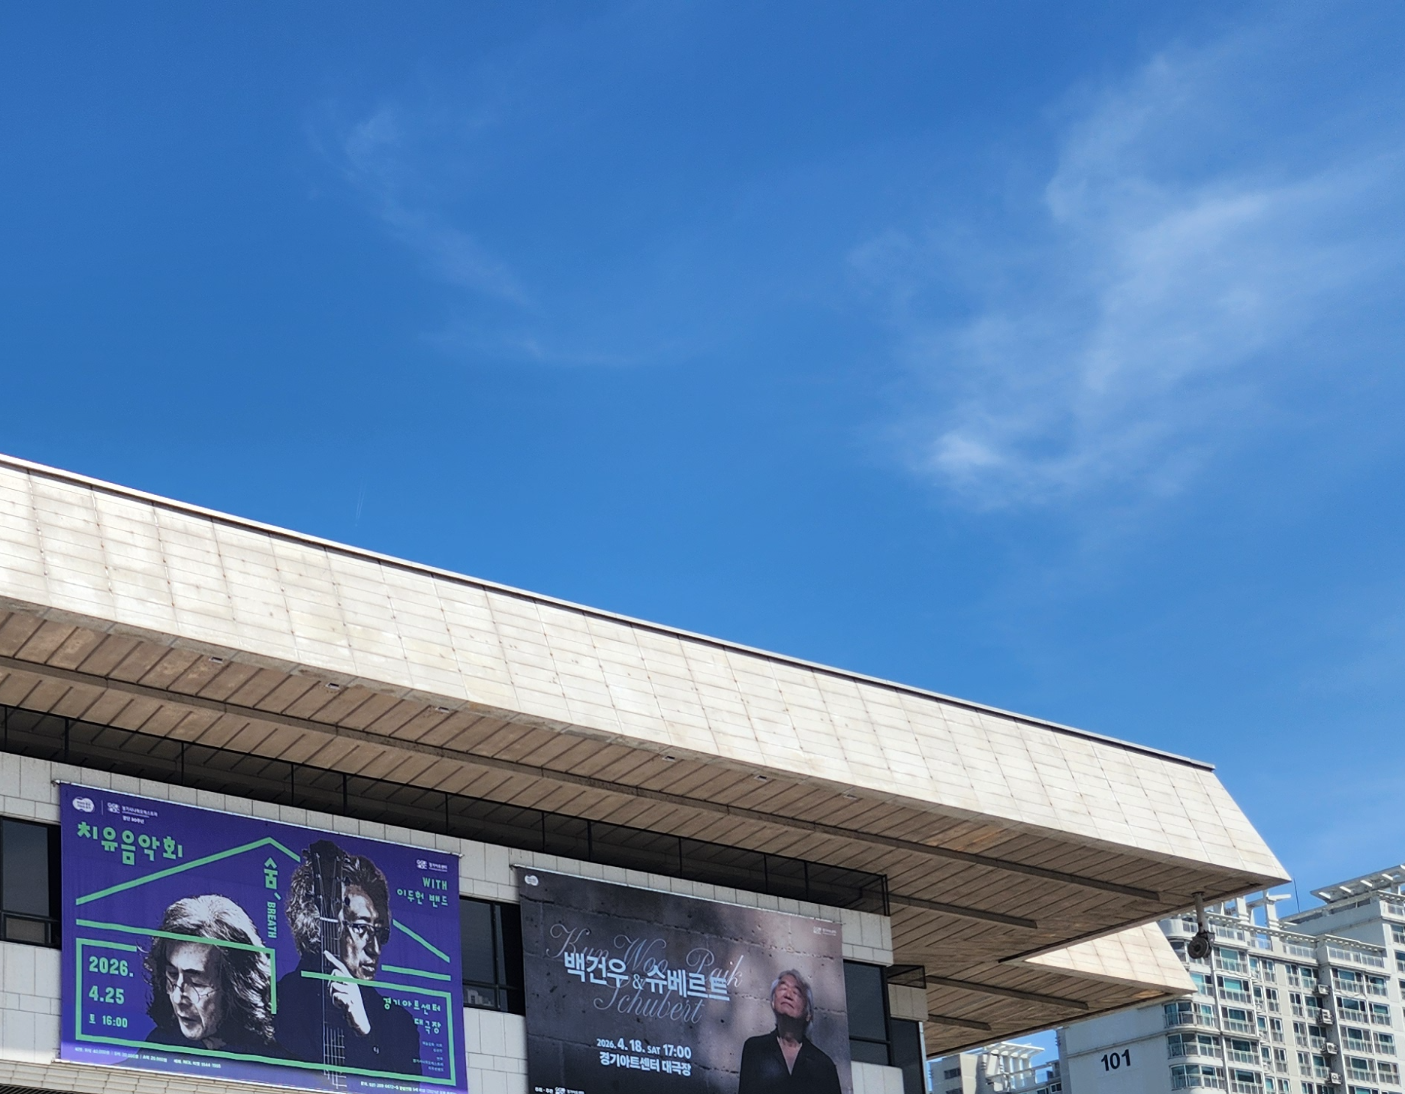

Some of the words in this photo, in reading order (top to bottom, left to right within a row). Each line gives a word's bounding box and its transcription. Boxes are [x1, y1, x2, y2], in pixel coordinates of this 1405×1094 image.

[77, 821, 183, 866] 치유음악회
[422, 877, 448, 890] WITH
[396, 888, 425, 905] 이두헌
[429, 893, 449, 907] 밴드
[266, 901, 277, 939] BREATH
[89, 956, 134, 977] 2026.
[564, 951, 629, 988] 백건우
[632, 973, 644, 990] &
[645, 965, 731, 1002] 슈베르트
[88, 985, 125, 1005] 4.25
[594, 977, 705, 1024] Schubert
[383, 997, 441, 1015] 경기아트센터
[89, 1013, 96, 1024] 토
[102, 1015, 128, 1028] 16:00
[414, 1018, 441, 1034] 대극장
[596, 1038, 617, 1049] 2026.
[647, 1045, 660, 1054] SAT
[663, 1043, 692, 1059] 17:00
[599, 1051, 660, 1072] 경기아트센터
[662, 1060, 691, 1077] 대극장
[1101, 1049, 1131, 1071] 101
